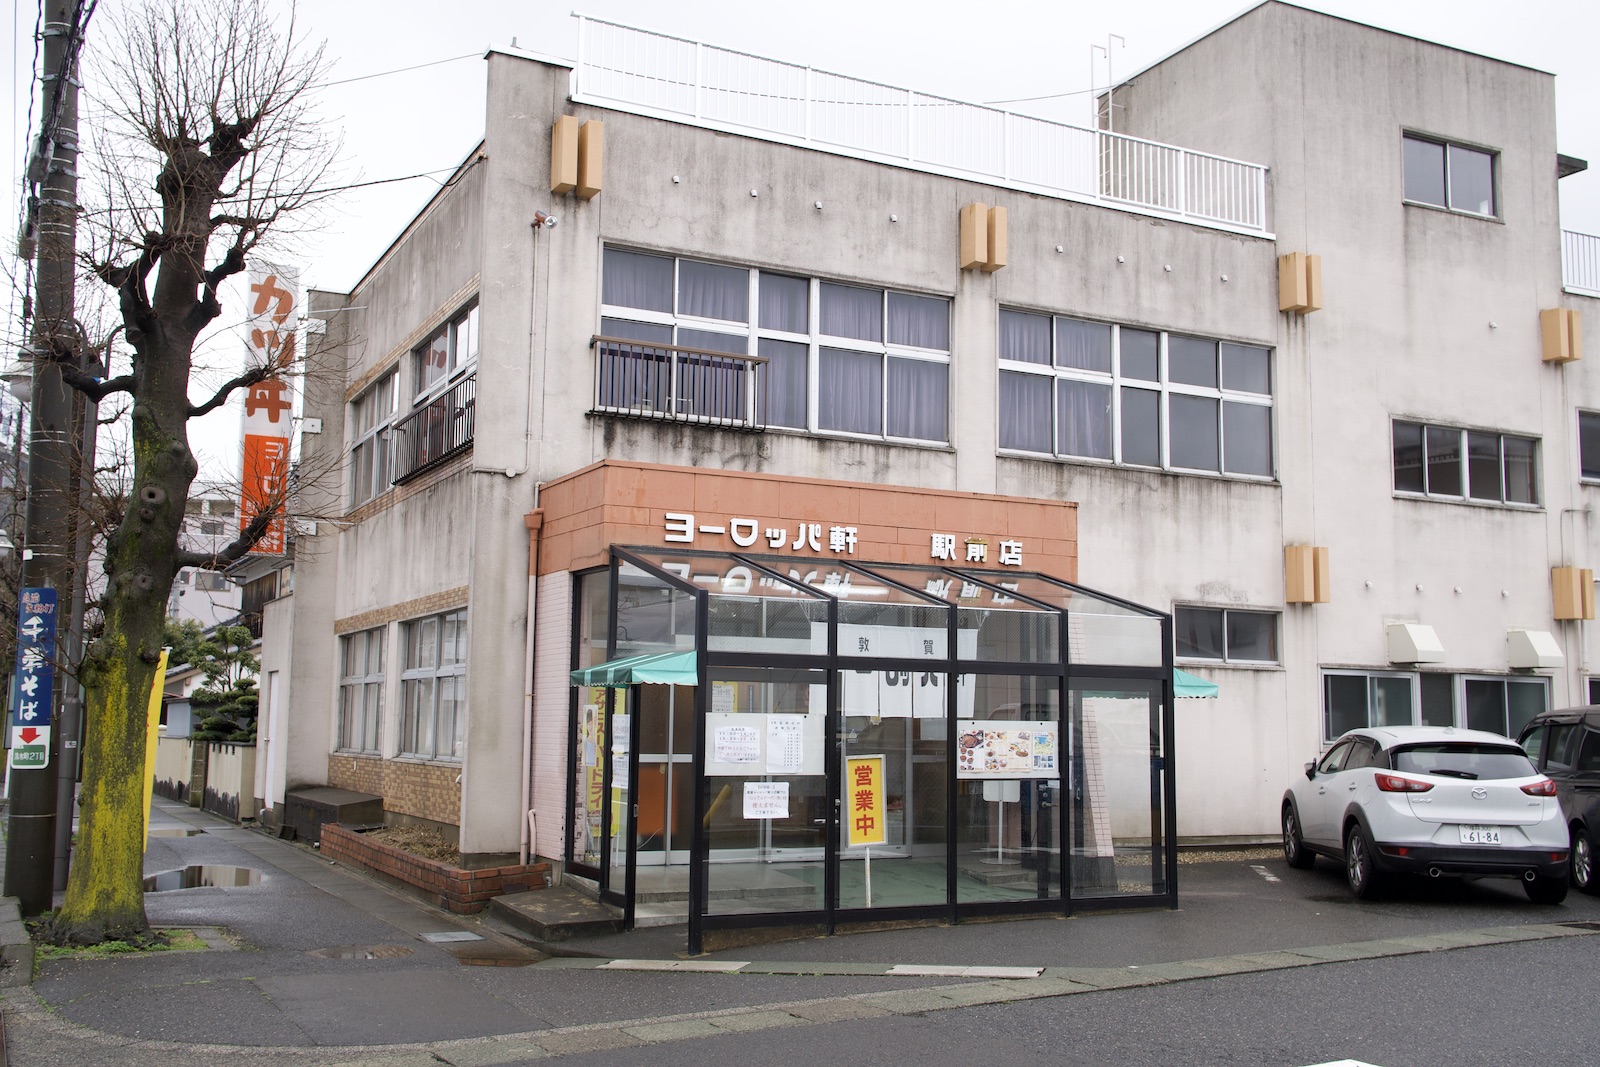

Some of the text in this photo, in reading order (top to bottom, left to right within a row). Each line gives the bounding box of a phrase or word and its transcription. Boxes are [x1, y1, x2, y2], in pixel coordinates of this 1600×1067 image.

[245, 275, 294, 423] カツ丼
[665, 512, 1023, 565] ヨーロッパ軒 駅前店
[858, 637, 934, 655] 敦賀
[854, 765, 875, 836] 営業中
[1469, 831, 1499, 842] 61-84
